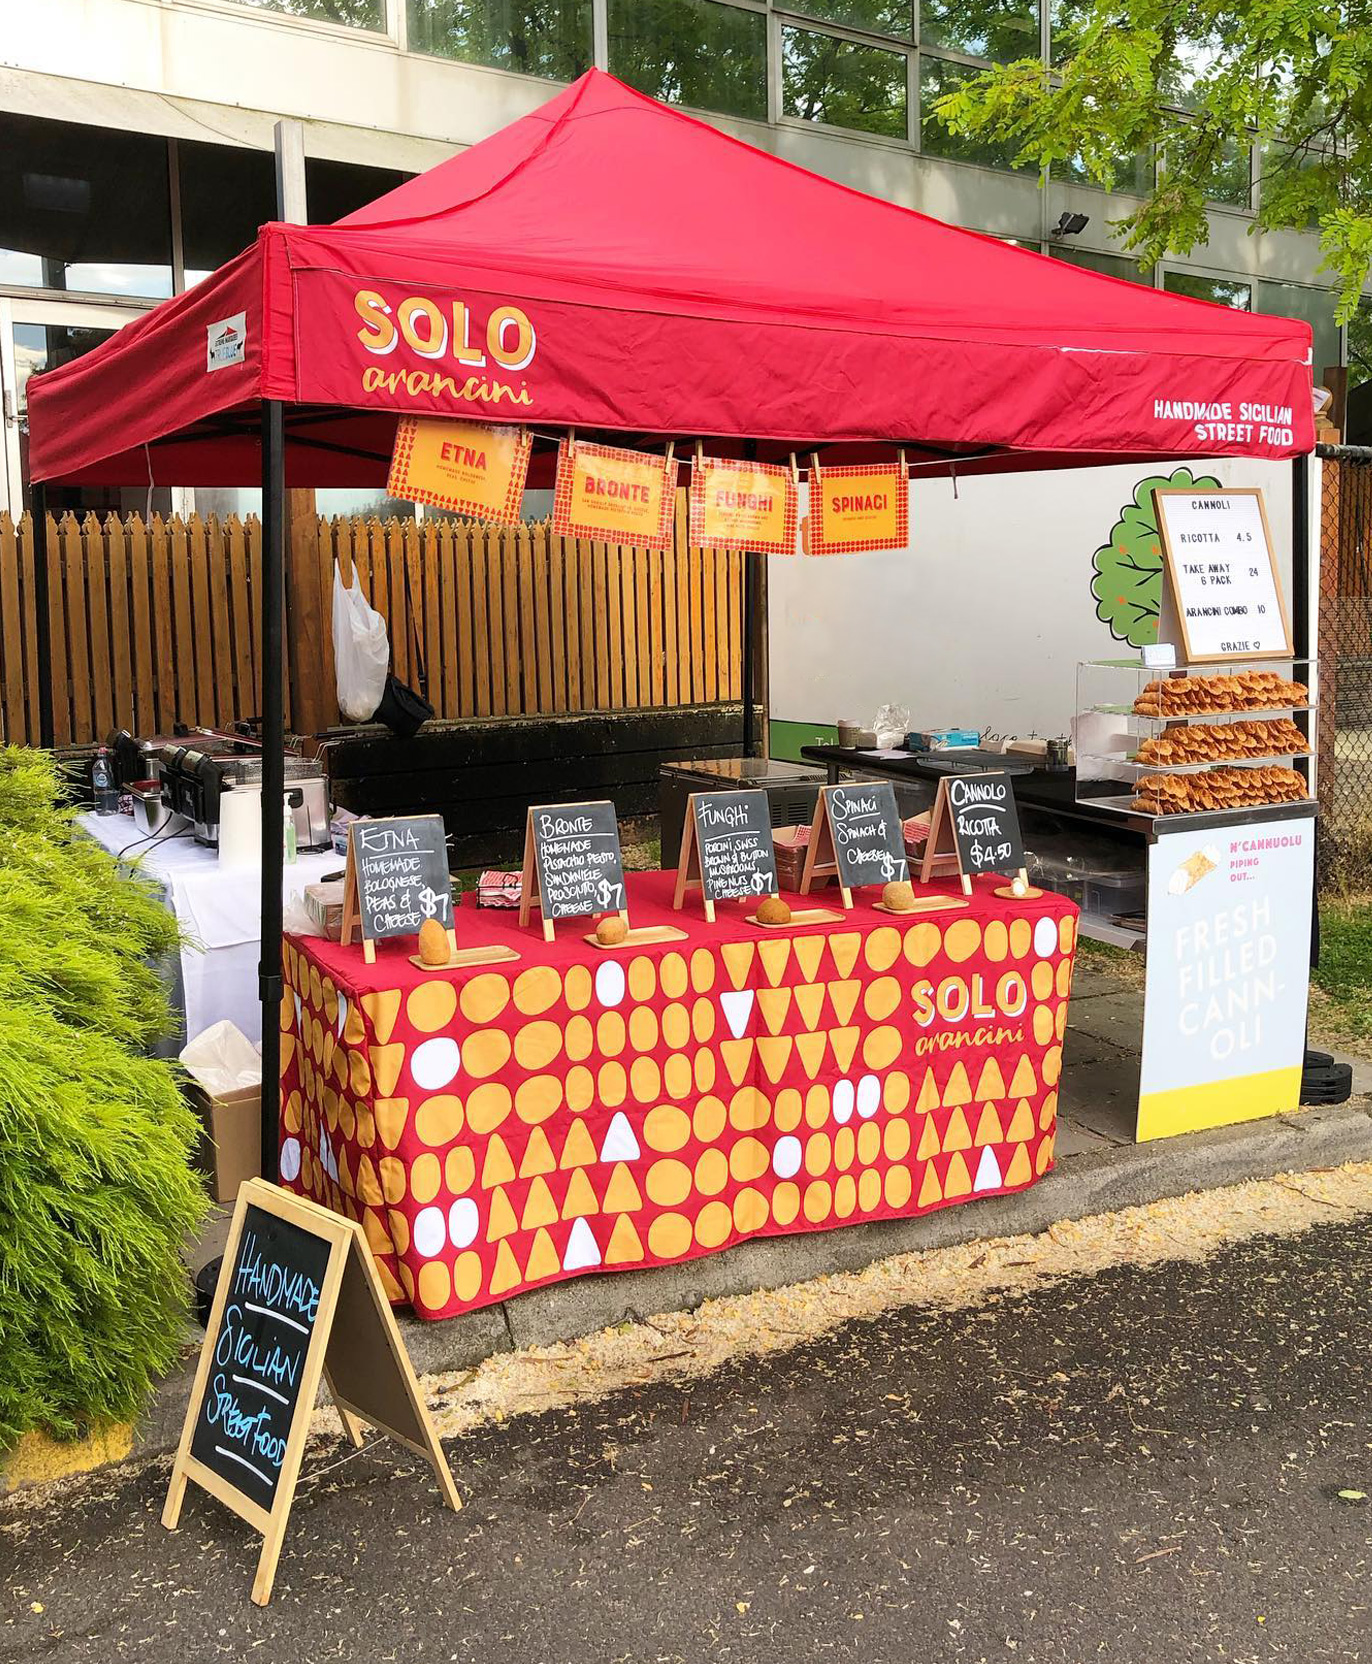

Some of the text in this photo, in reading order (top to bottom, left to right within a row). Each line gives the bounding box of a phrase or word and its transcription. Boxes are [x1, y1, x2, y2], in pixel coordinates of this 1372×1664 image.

[354, 289, 537, 371] SOLO
[362, 366, 534, 406] arancini
[1154, 399, 1293, 426] HANDMADE SICILIAN
[1194, 422, 1294, 446] STREET FOOD
[440, 441, 487, 471] ETNA
[585, 476, 650, 503] BRONTE
[716, 490, 773, 512] FUNGHI
[832, 494, 887, 513] SPINACI
[1191, 500, 1231, 510] CANNOLI
[1180, 532, 1252, 543] RICOTTA 4.5
[1183, 563, 1259, 577] TAKE AWAY 24
[1201, 575, 1232, 586] 6 PACK
[1186, 604, 1266, 618] ARANCINI COMBO 10
[1220, 641, 1251, 651] GRAZIE
[950, 779, 1006, 806] CANNOLO
[539, 814, 593, 839] BRONTE
[836, 822, 876, 845] SPINACH
[956, 815, 1002, 837] RICOTTA
[359, 827, 420, 852] ETNA
[880, 851, 906, 882] $7
[970, 838, 1012, 869] $4.50
[1230, 857, 1259, 869] PIPING
[364, 894, 396, 915] PEAS
[418, 887, 450, 921] $7
[597, 878, 623, 909] $7
[714, 885, 752, 900] CHEESE
[551, 900, 593, 917] CHEESE
[373, 911, 421, 933] CHEESE
[1175, 895, 1269, 961] FRESH
[1179, 934, 1277, 998] FILLED
[910, 970, 1027, 1027] SOLO
[1179, 970, 1285, 1036] CANN-
[915, 1022, 1025, 1057] arancini
[1210, 1013, 1261, 1060] OLI
[235, 1230, 320, 1323] HANDMADE
